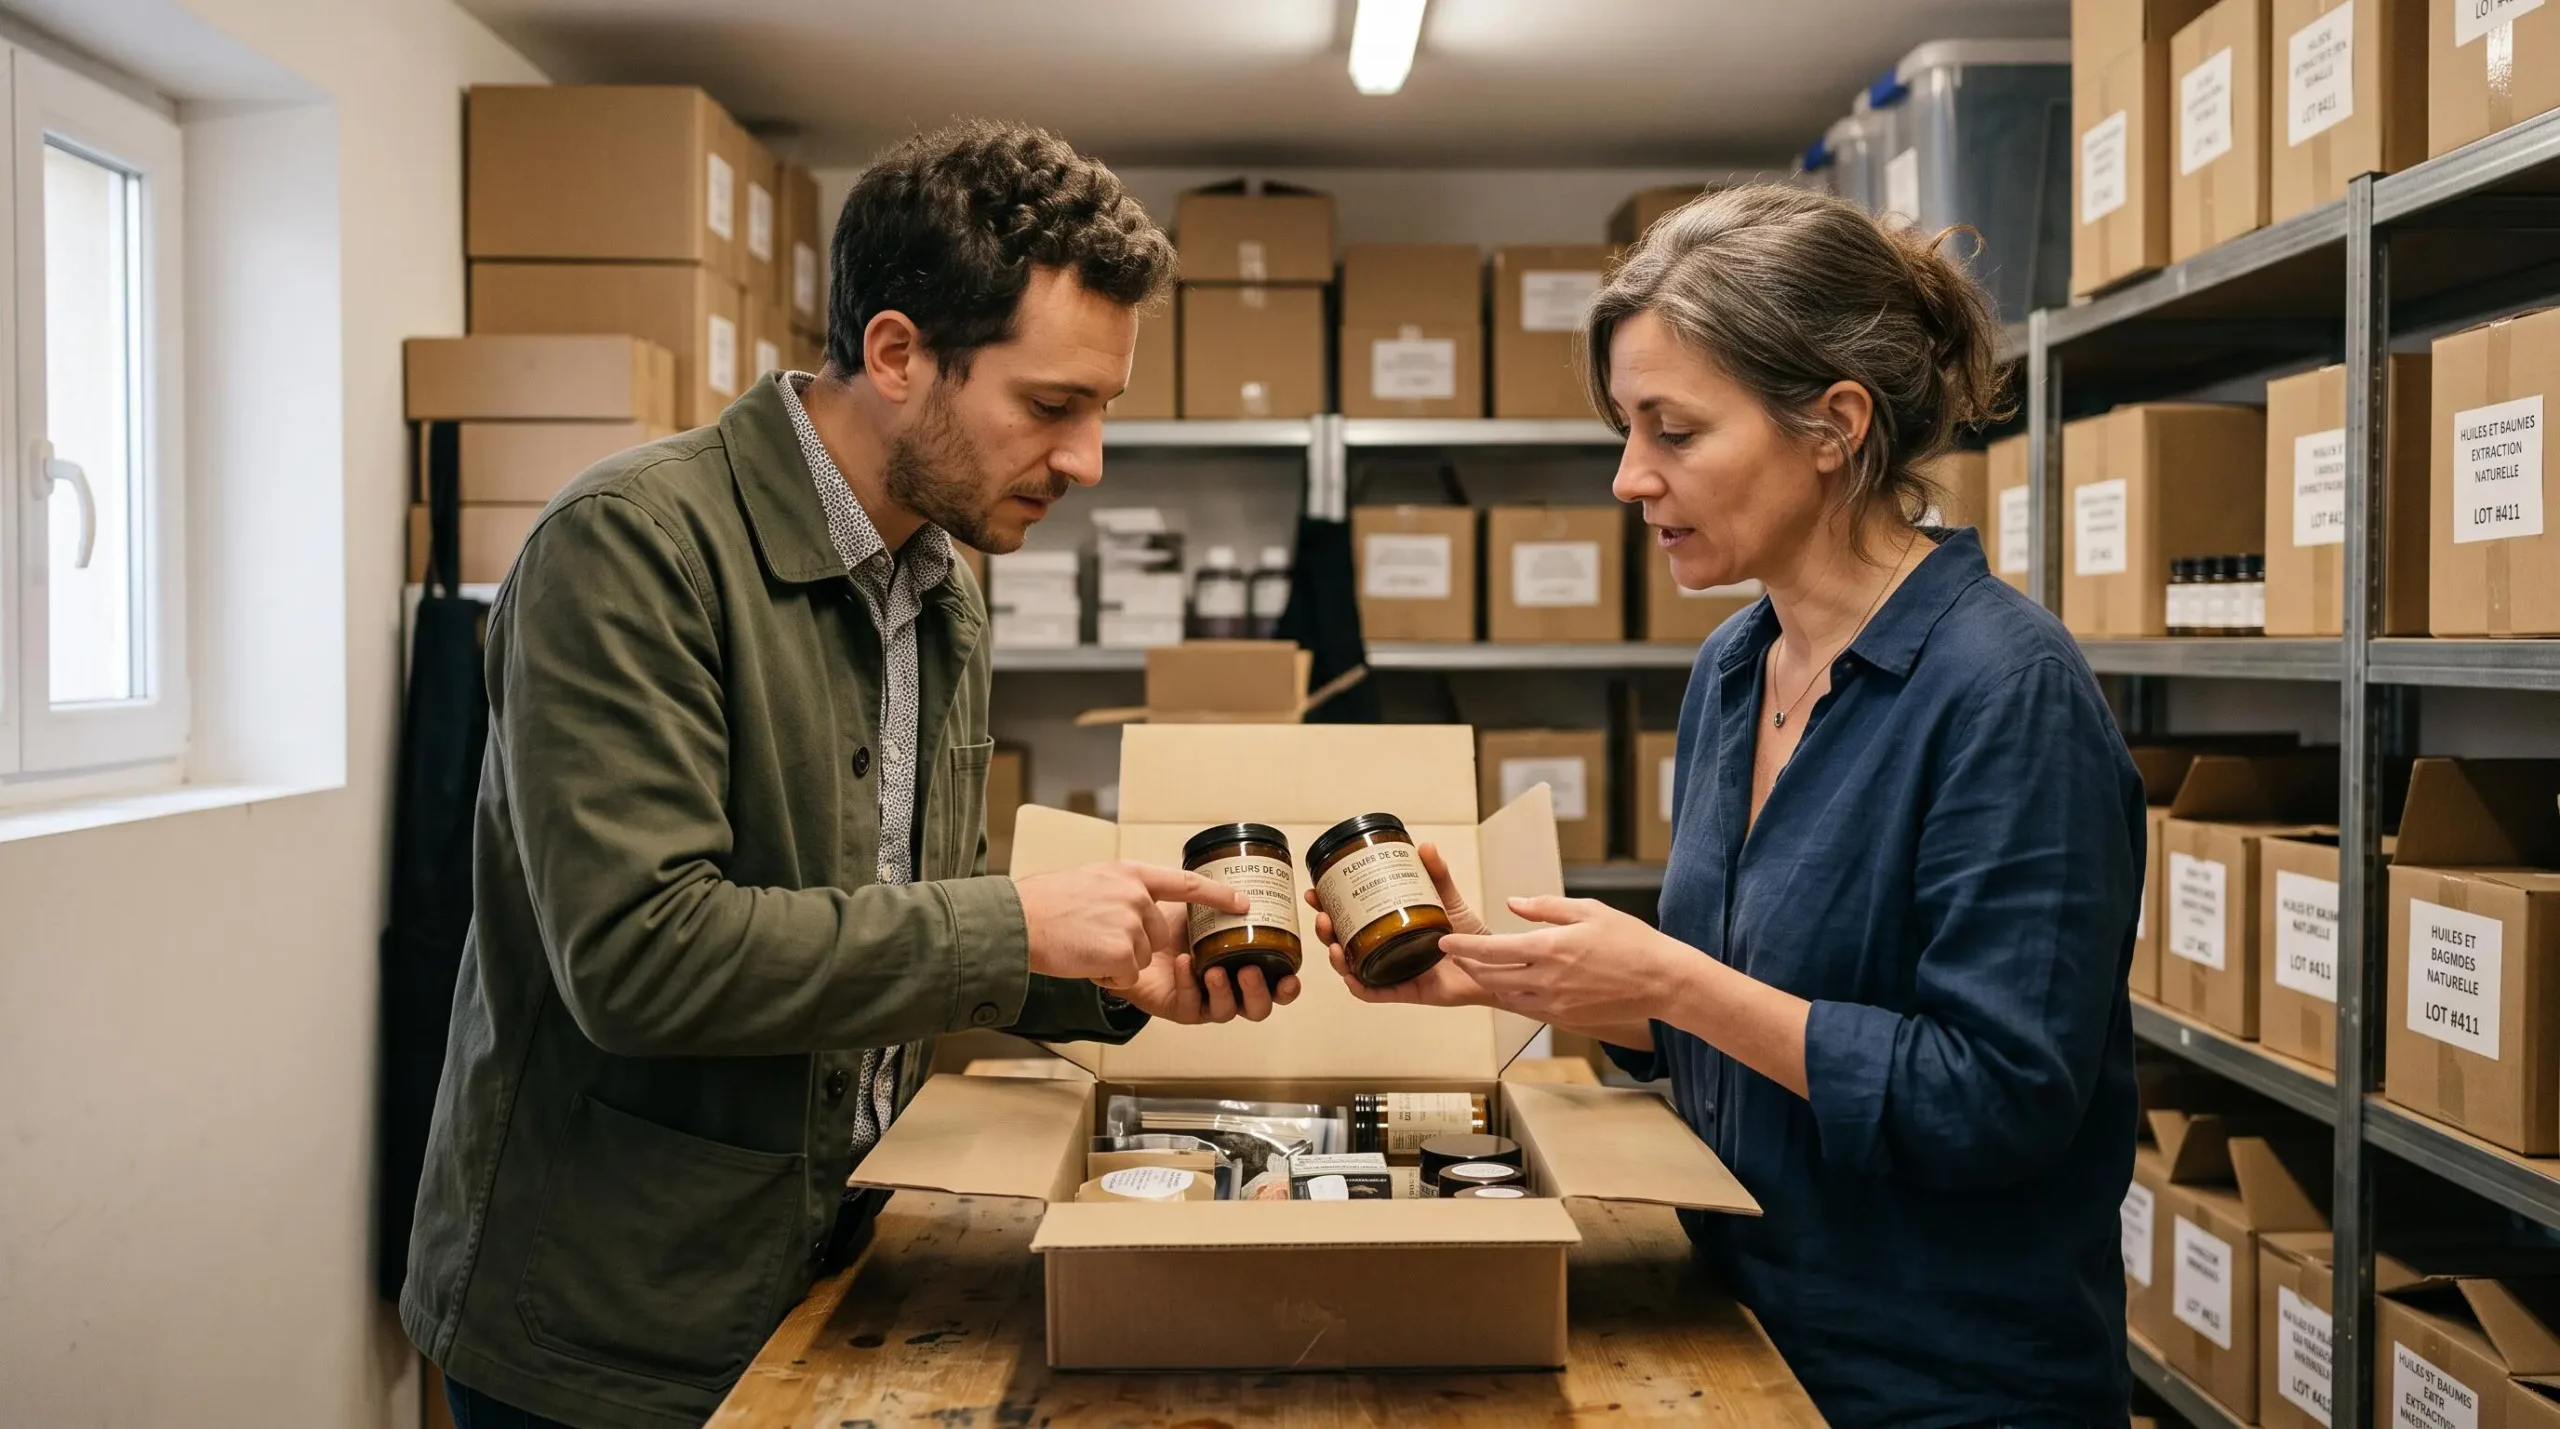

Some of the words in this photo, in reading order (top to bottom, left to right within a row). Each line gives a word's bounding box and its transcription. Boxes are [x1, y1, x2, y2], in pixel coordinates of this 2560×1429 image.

[2460, 424, 2488, 442] HUILES
[2489, 422, 2498, 437] ET
[2471, 441, 2522, 462] EXTRACTION
[2475, 464, 2519, 483] NATURELLE
[2474, 507, 2492, 525] LOT
[2496, 503, 2520, 522] #411
[1378, 851, 1391, 860] DE
[1224, 864, 1260, 875] FLEURS
[1263, 865, 1274, 875] DE
[2431, 925, 2462, 946] HUILES
[2465, 934, 2476, 949] ET
[2290, 954, 2306, 971] LOT
[2309, 960, 2331, 980] #411
[2427, 968, 2479, 996] NATURELLE
[2426, 1002, 2447, 1024] LOT
[2450, 1010, 2480, 1036] #411
